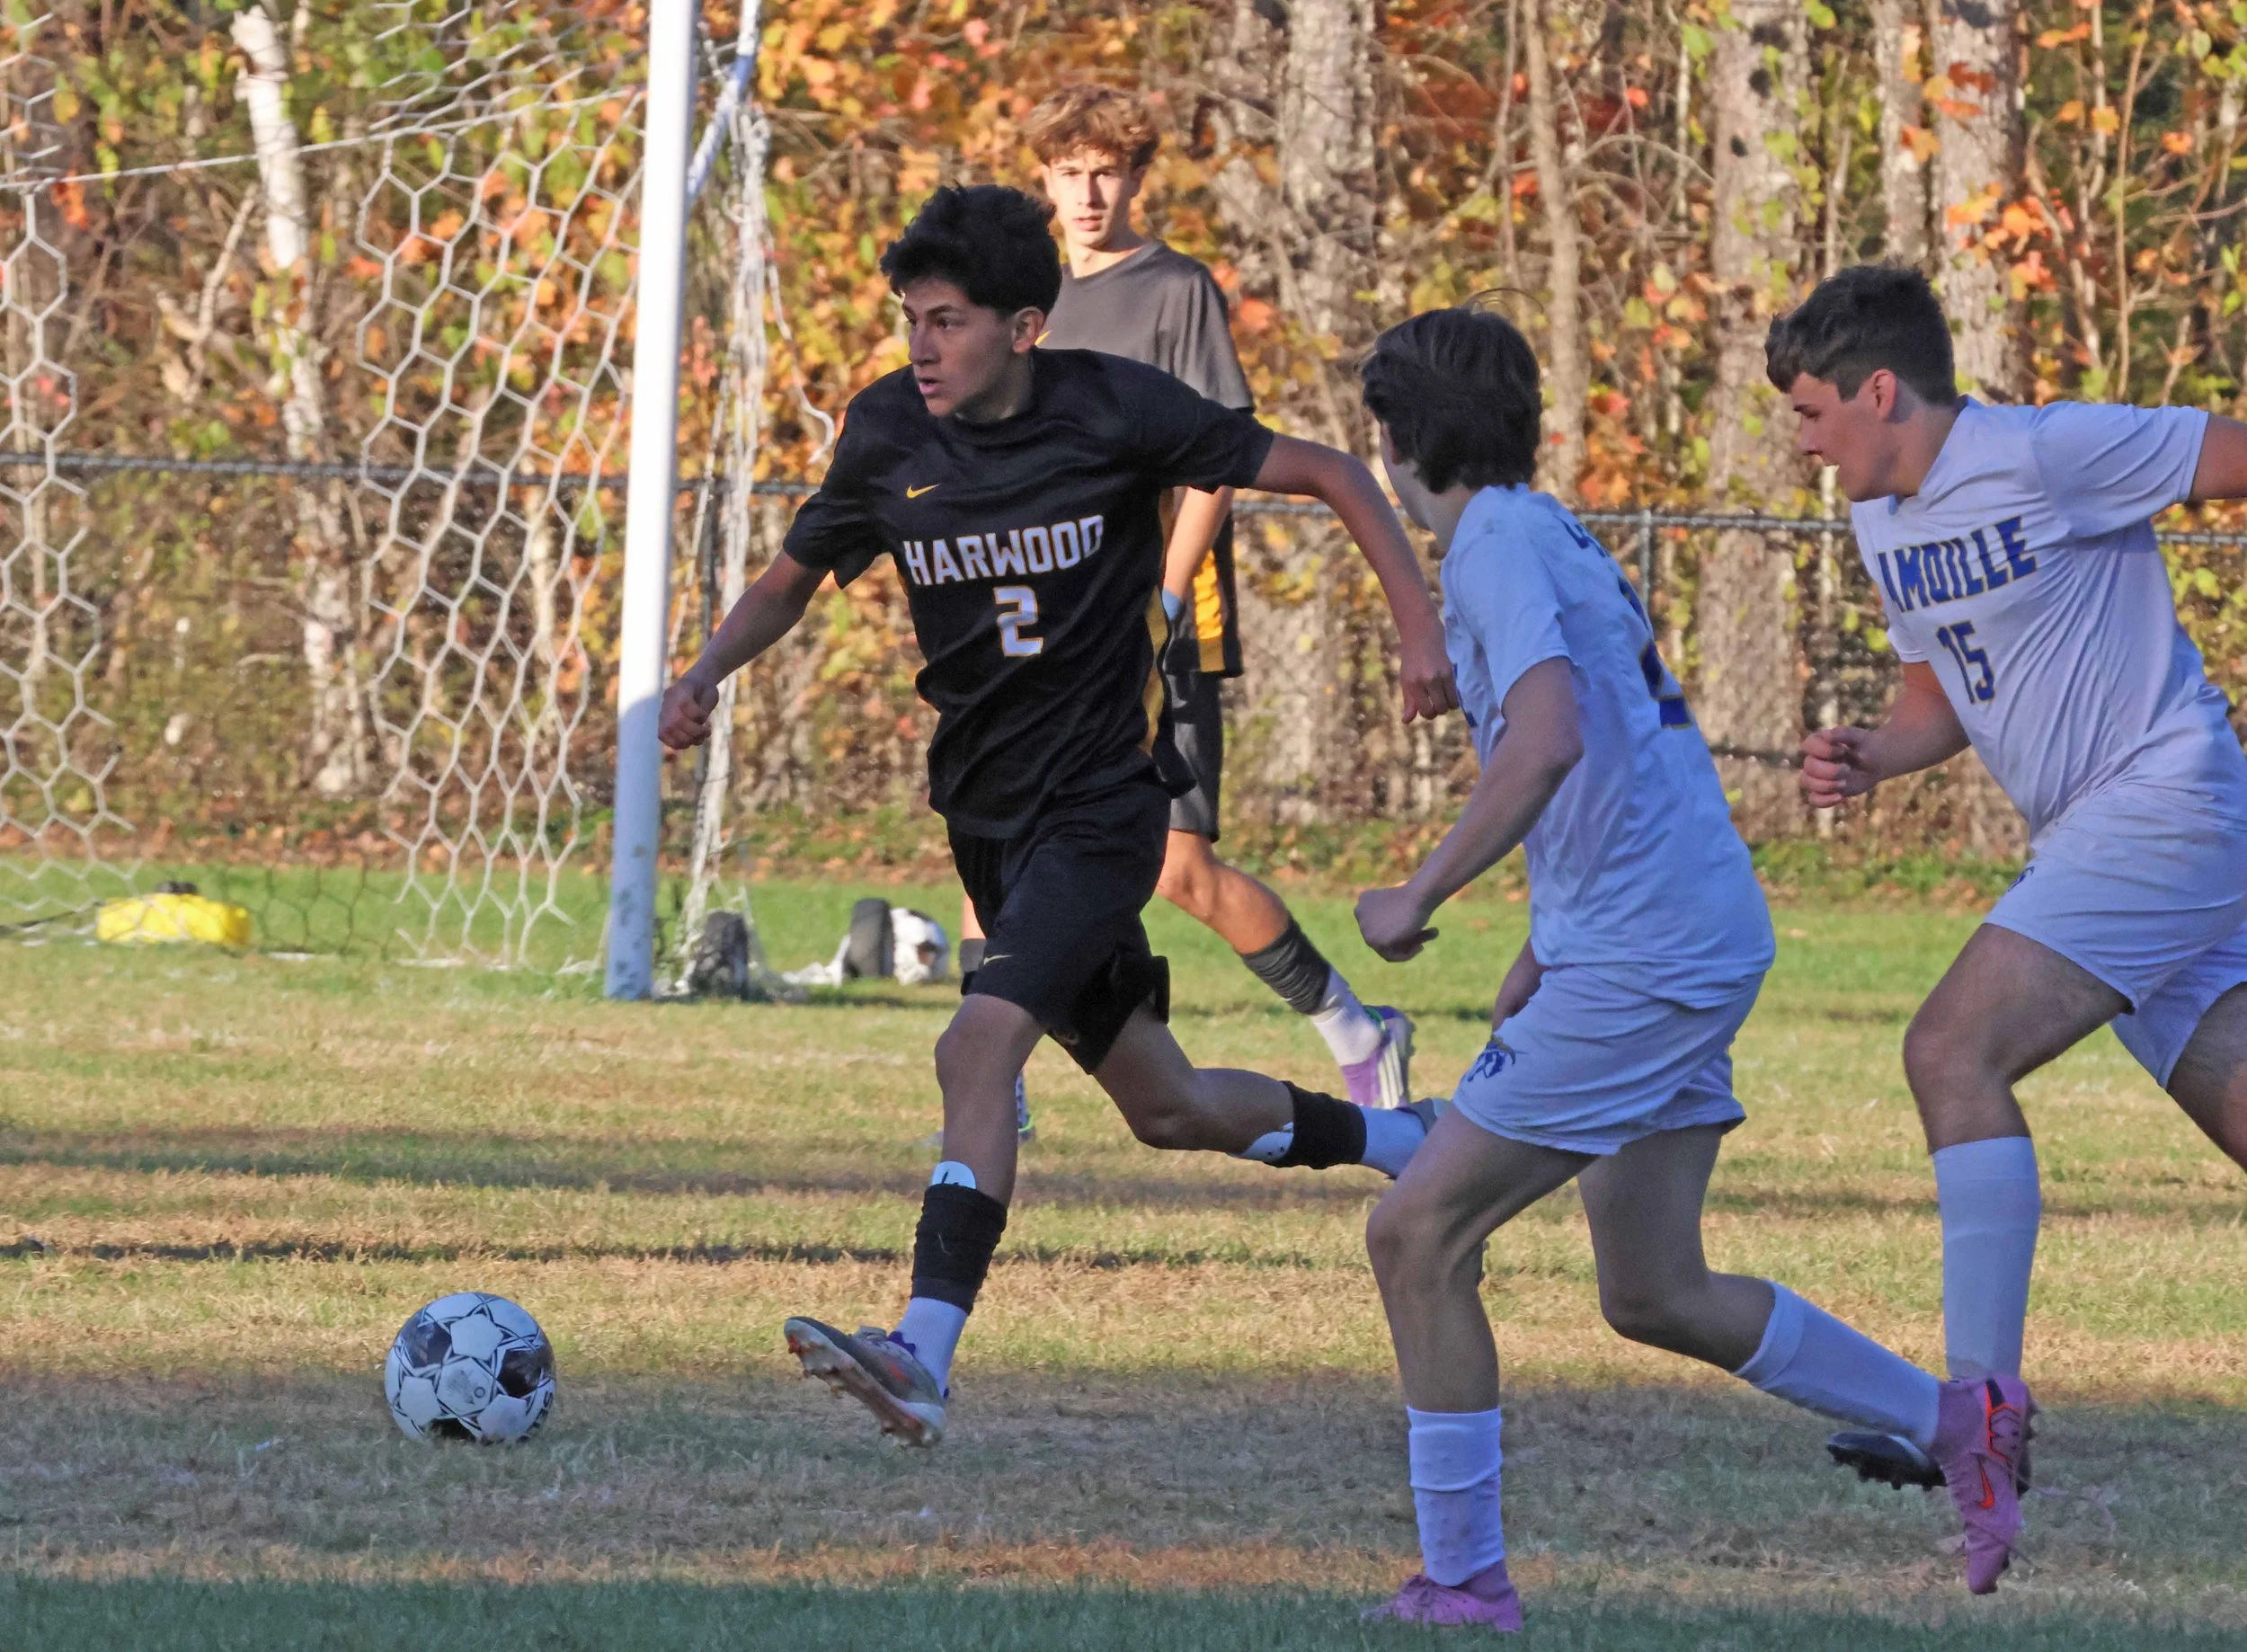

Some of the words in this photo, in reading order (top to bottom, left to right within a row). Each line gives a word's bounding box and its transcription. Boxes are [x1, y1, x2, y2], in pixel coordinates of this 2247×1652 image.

[903, 515, 1104, 585] HARWOOD
[993, 585, 1044, 657] 2
[1936, 620, 1995, 704] 15
